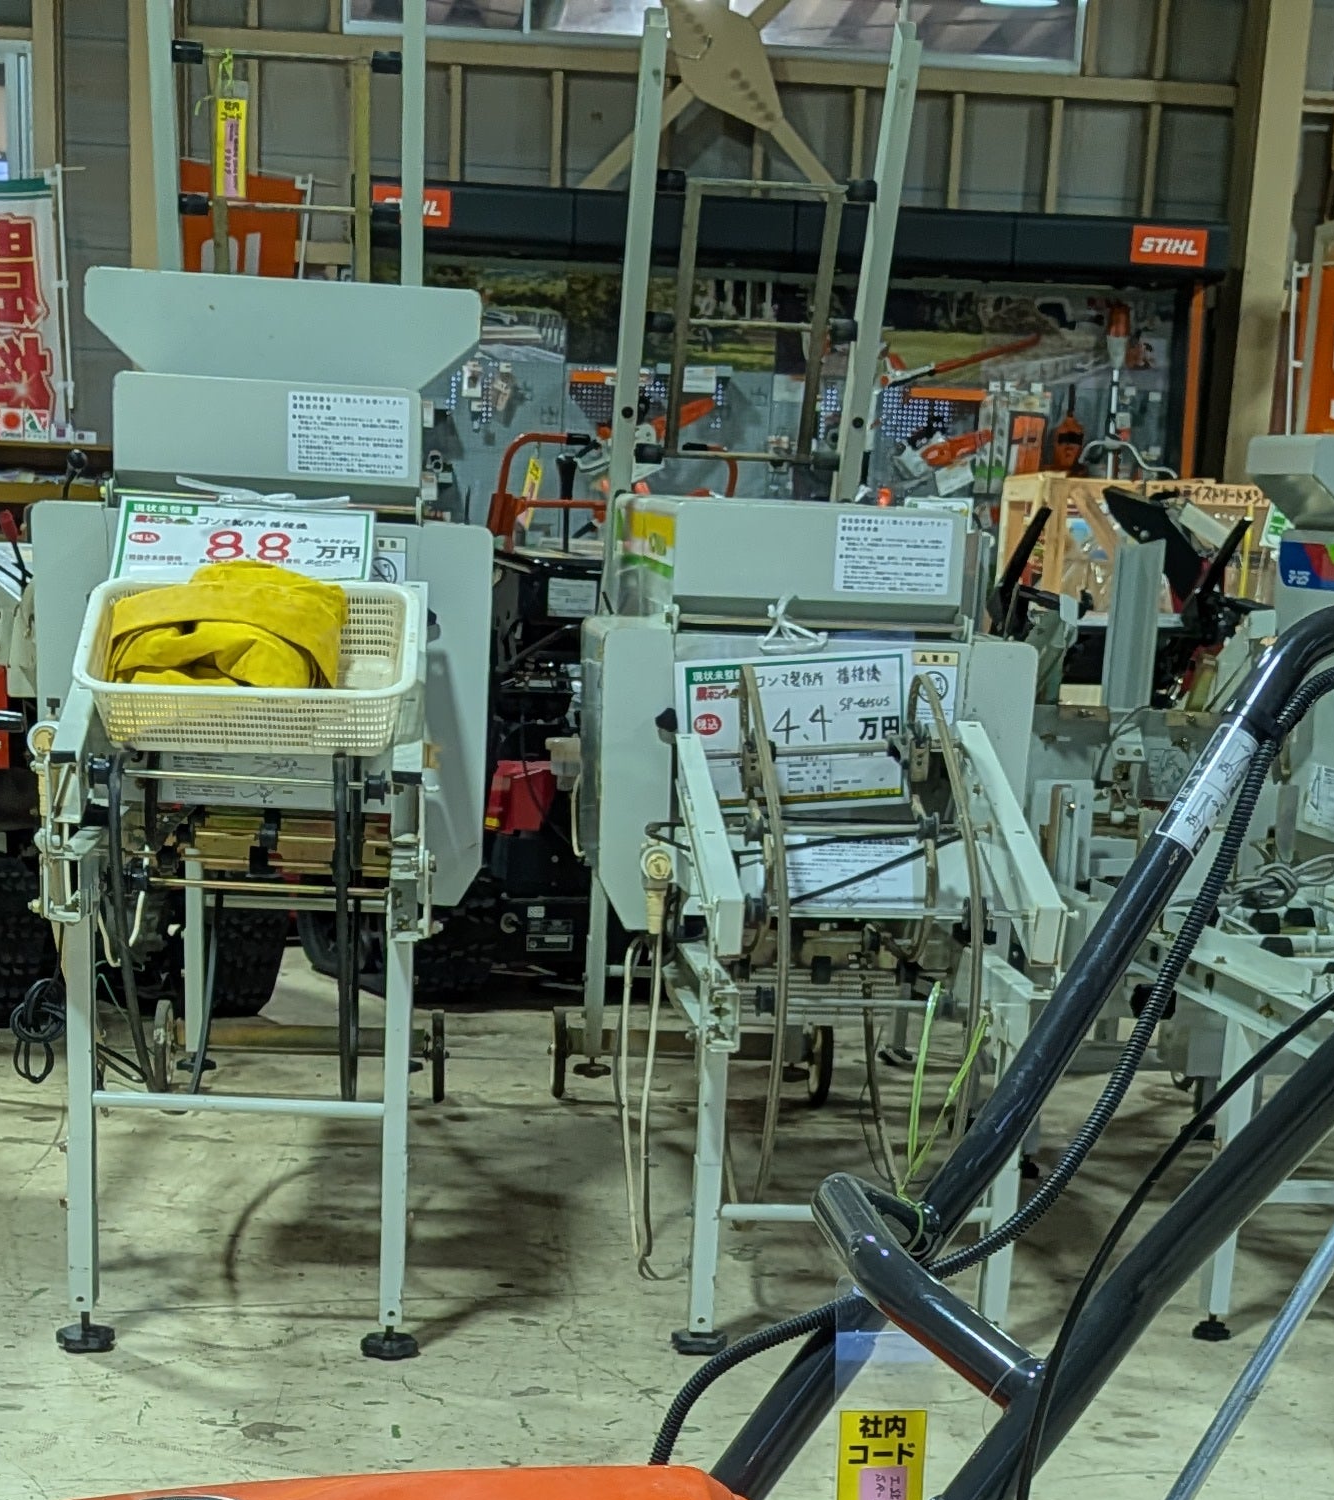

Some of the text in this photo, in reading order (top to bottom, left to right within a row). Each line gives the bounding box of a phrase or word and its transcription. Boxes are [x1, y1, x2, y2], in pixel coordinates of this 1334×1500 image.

[1139, 236, 1199, 256] STIHL
[205, 530, 292, 562] 8.8
[316, 544, 361, 560] 万円
[858, 715, 900, 741] 万円
[859, 1415, 908, 1439] 社内
[848, 1442, 917, 1466] コード
